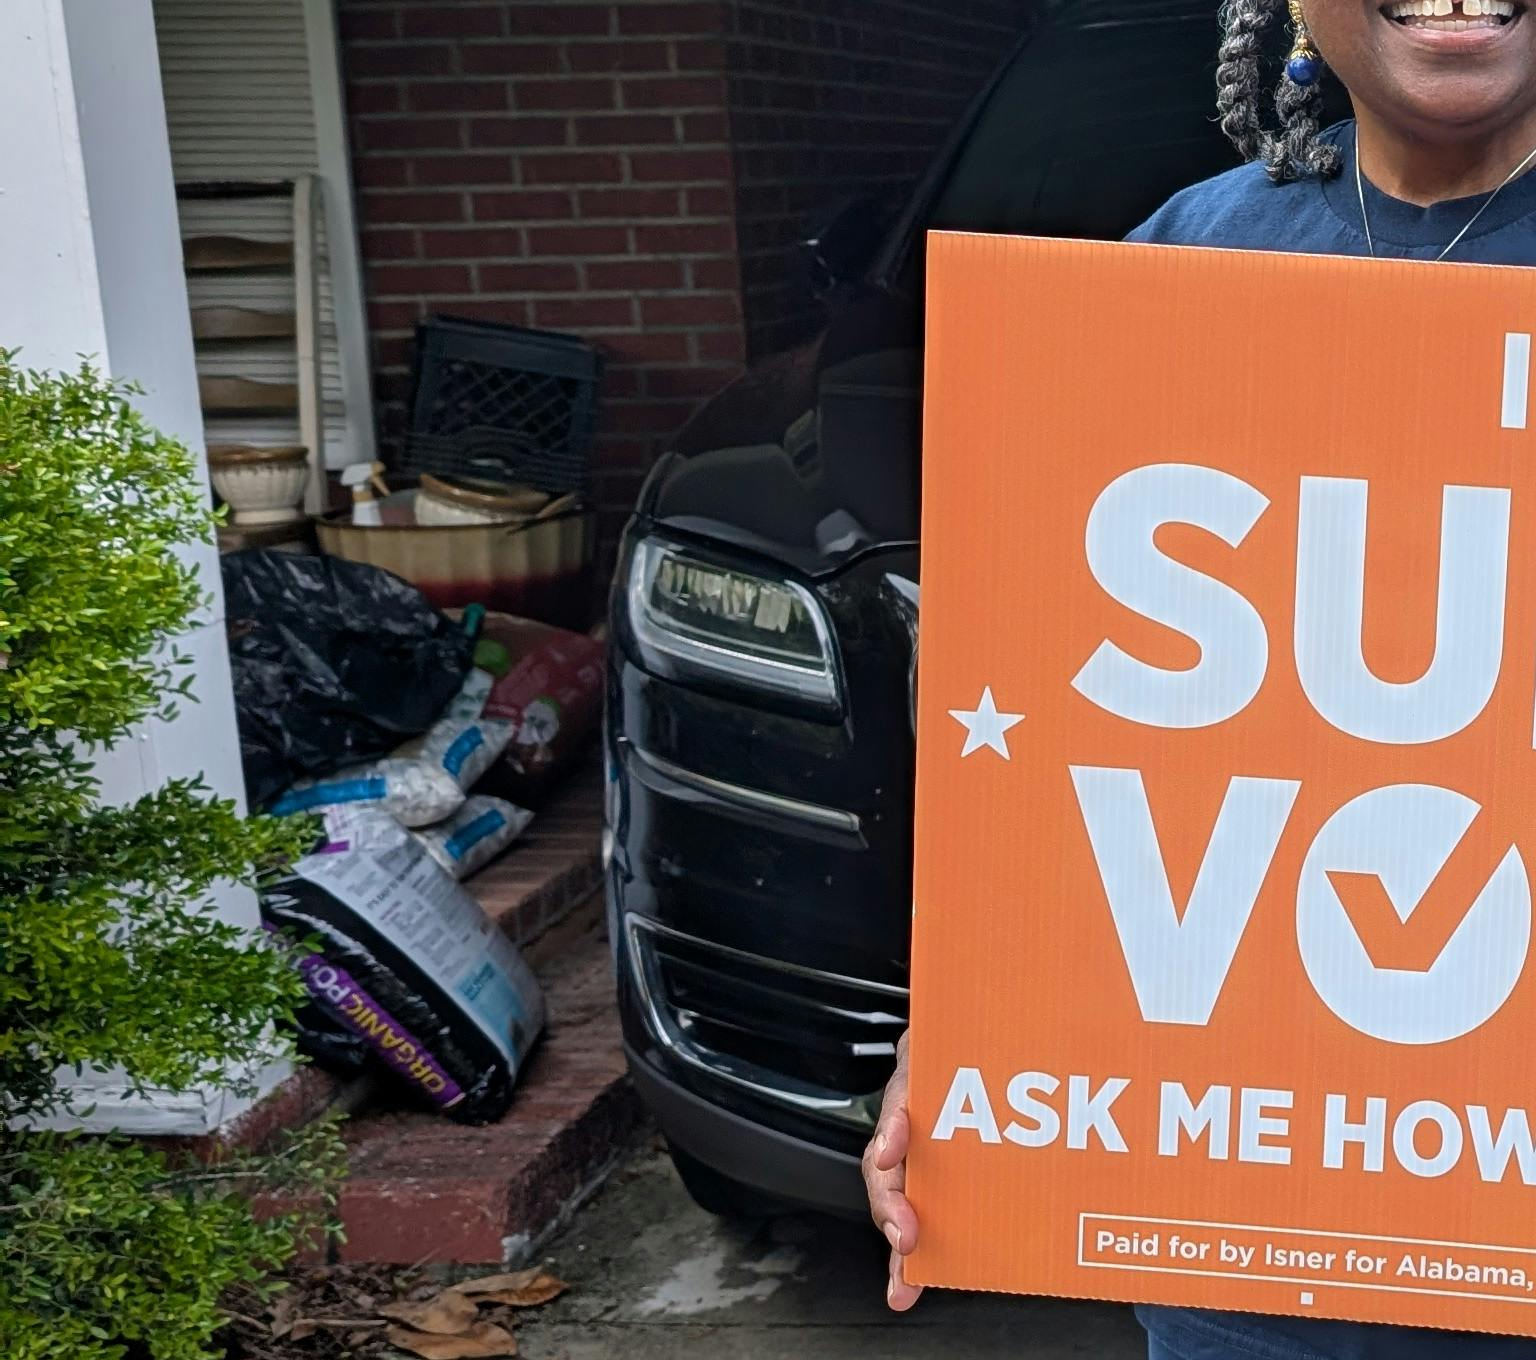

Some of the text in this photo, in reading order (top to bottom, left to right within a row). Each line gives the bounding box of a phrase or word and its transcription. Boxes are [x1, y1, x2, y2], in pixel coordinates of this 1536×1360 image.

[344, 993, 448, 1096] ORGANIC
[931, 1067, 1131, 1153] ASK
[1158, 1081, 1294, 1165] ME
[1097, 1230, 1159, 1256] Paid
[1168, 1235, 1210, 1259] for
[1220, 1239, 1255, 1267] by
[1265, 1244, 1336, 1270] Isner
[1345, 1249, 1387, 1274] for
[1396, 1255, 1533, 1291] Alabama,
